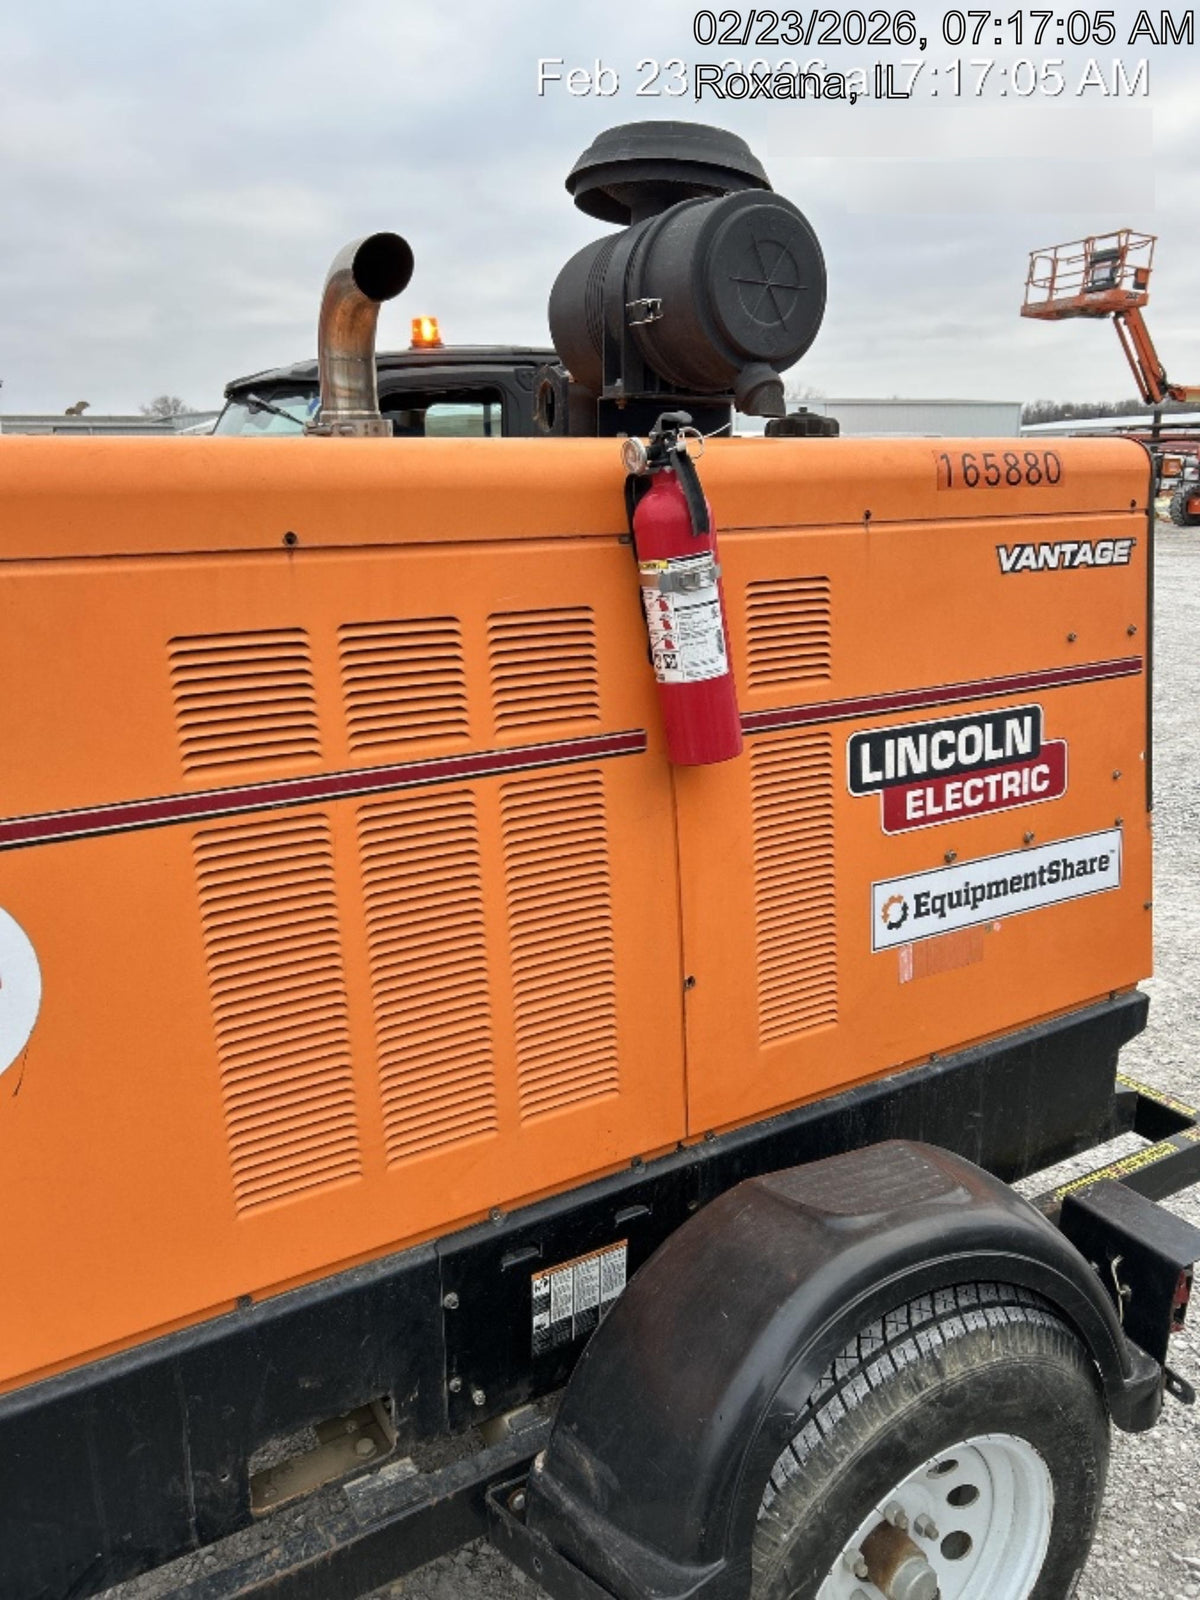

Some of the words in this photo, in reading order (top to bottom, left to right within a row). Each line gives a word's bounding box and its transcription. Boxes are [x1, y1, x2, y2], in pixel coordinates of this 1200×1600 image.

[940, 451, 1062, 488] 165880
[997, 538, 1134, 573] VANTAGE
[860, 714, 1033, 785] LINCOLN
[905, 765, 1051, 821] ELECTRIC
